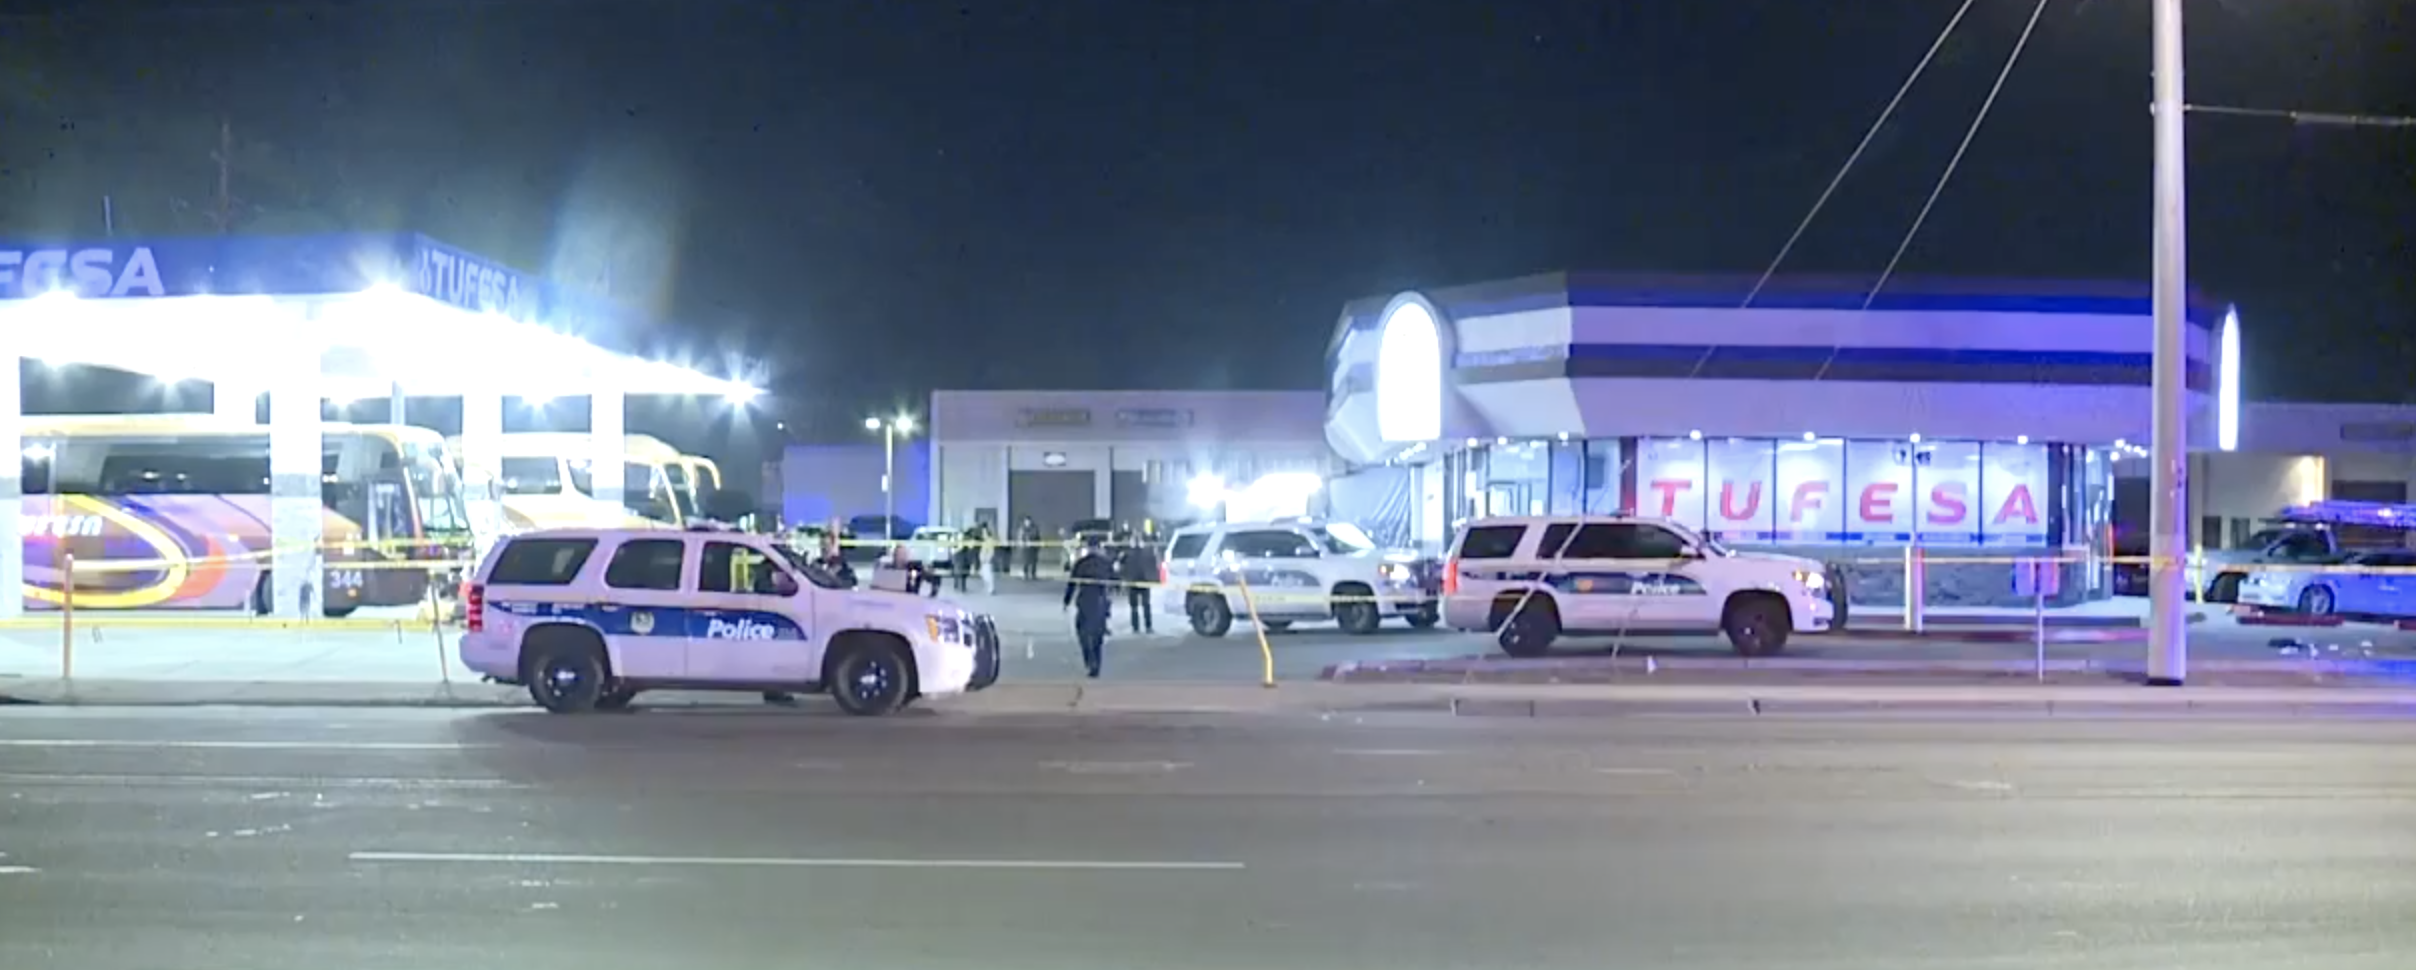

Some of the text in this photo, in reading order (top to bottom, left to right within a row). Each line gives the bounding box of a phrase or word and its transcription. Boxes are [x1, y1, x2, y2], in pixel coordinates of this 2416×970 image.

[1650, 479, 2039, 524] TUFESA
[329, 569, 363, 588] 344
[707, 618, 775, 640] Police
